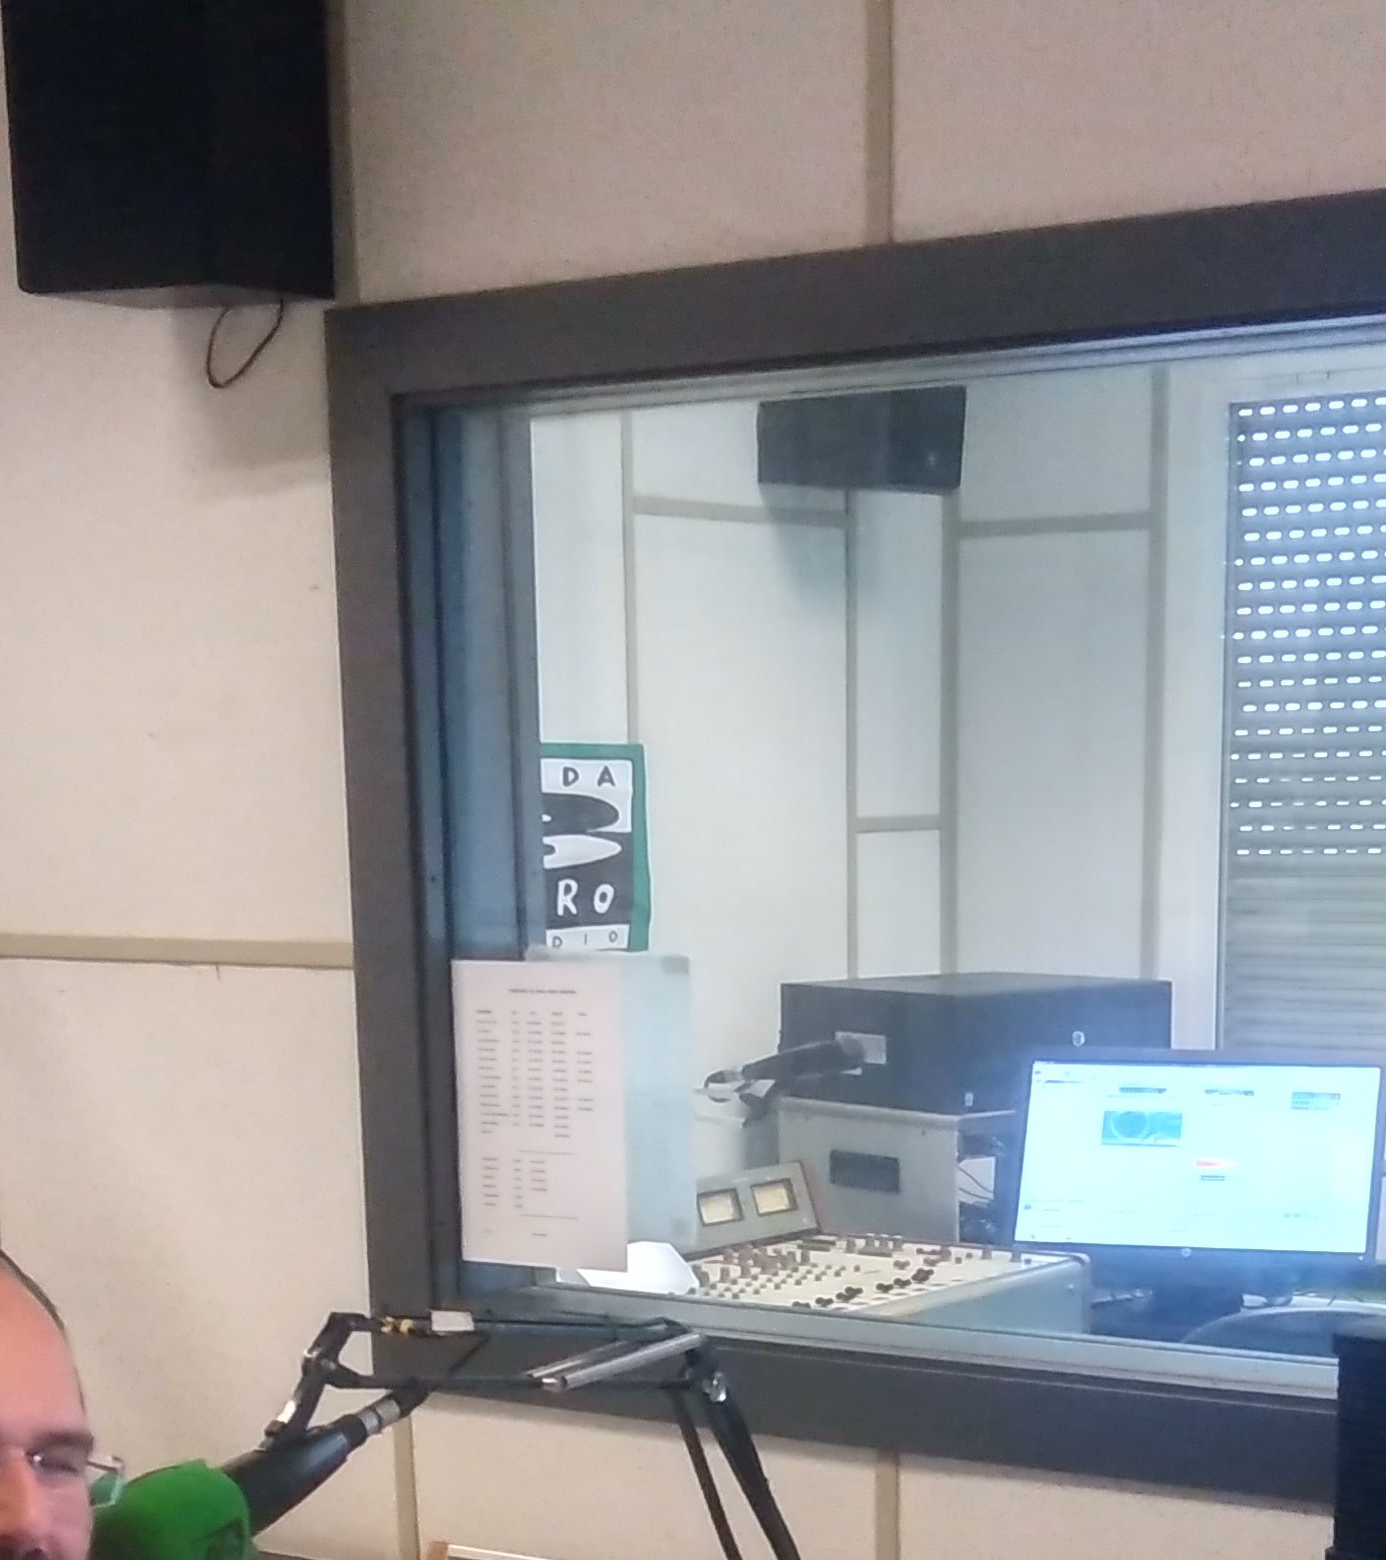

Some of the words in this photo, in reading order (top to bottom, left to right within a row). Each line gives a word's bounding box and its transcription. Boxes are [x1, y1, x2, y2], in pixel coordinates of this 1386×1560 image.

[562, 765, 616, 788] DA
[557, 878, 615, 917] RO
[552, 930, 619, 948] DIO
